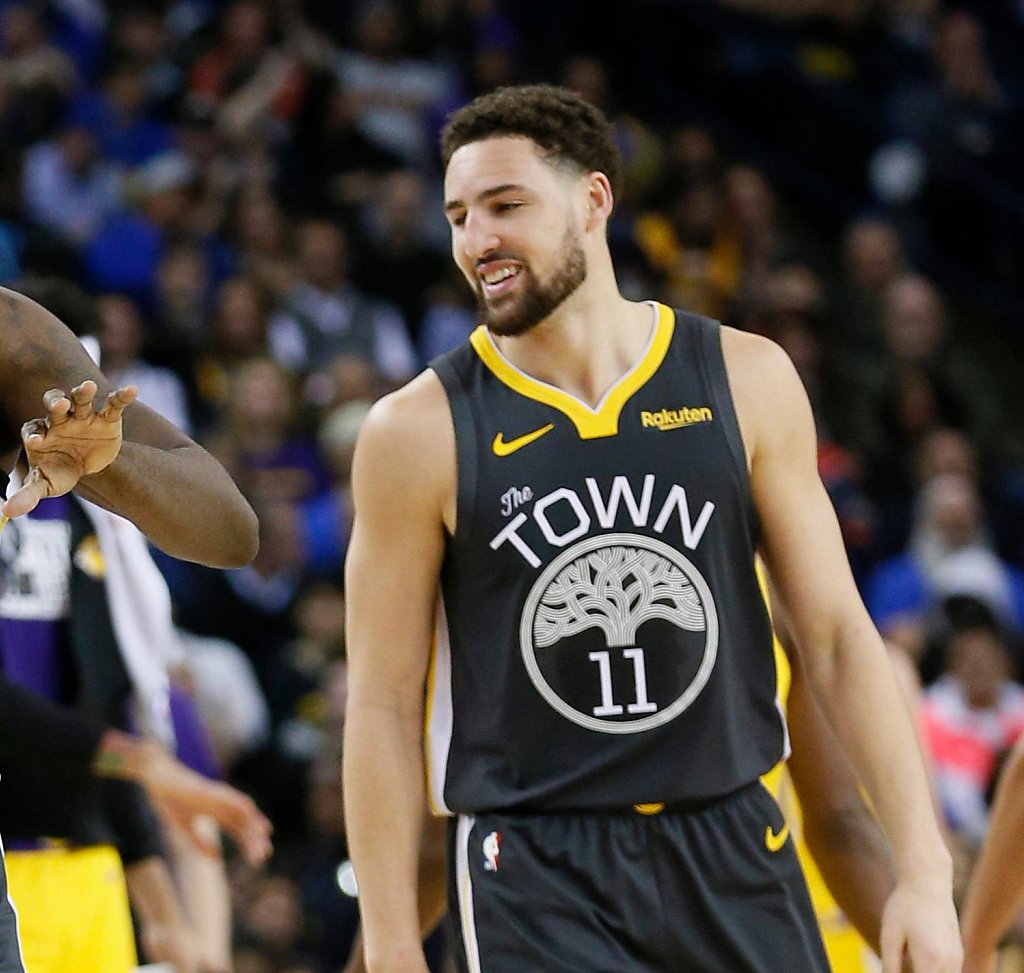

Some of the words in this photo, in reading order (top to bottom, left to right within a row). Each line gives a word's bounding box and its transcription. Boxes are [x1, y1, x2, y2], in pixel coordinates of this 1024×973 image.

[641, 407, 712, 429] Rakuten
[489, 474, 714, 568] TOWN
[500, 486, 533, 517] The
[588, 648, 657, 716] 11
